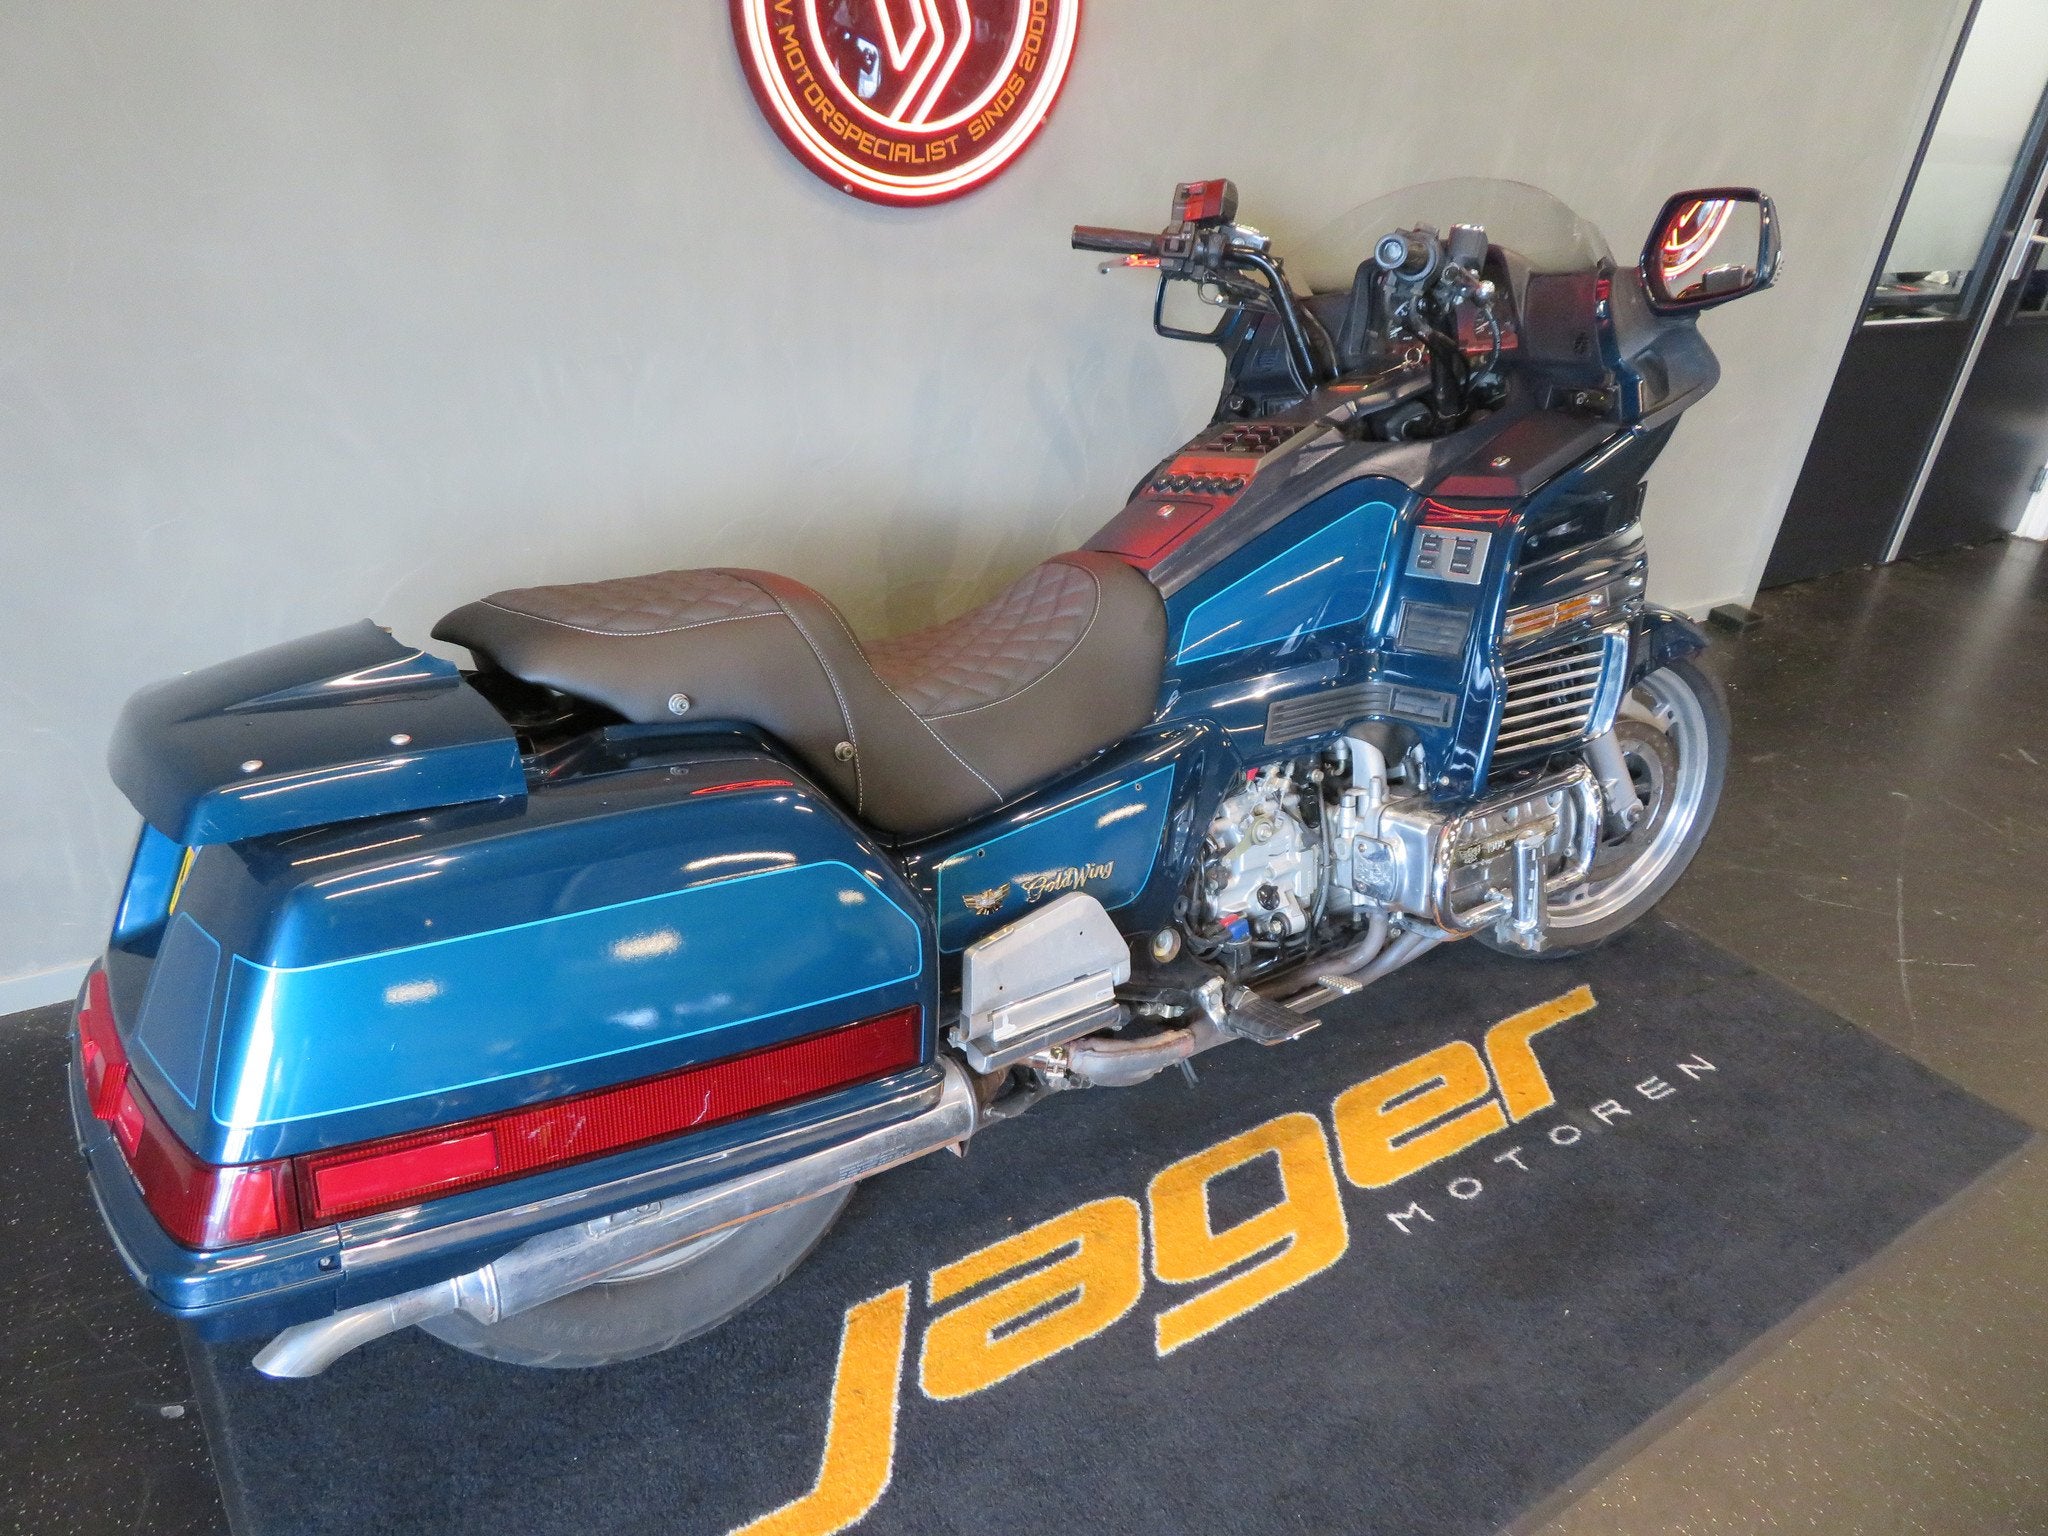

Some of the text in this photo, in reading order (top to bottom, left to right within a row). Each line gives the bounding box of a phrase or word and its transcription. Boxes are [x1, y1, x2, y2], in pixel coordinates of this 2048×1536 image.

[779, 25, 959, 163] MOTORSPECIALIST
[968, 72, 1025, 141] SINDS
[1020, 0, 1048, 72] 2000
[1386, 1054, 1717, 1235] MOTOREN
